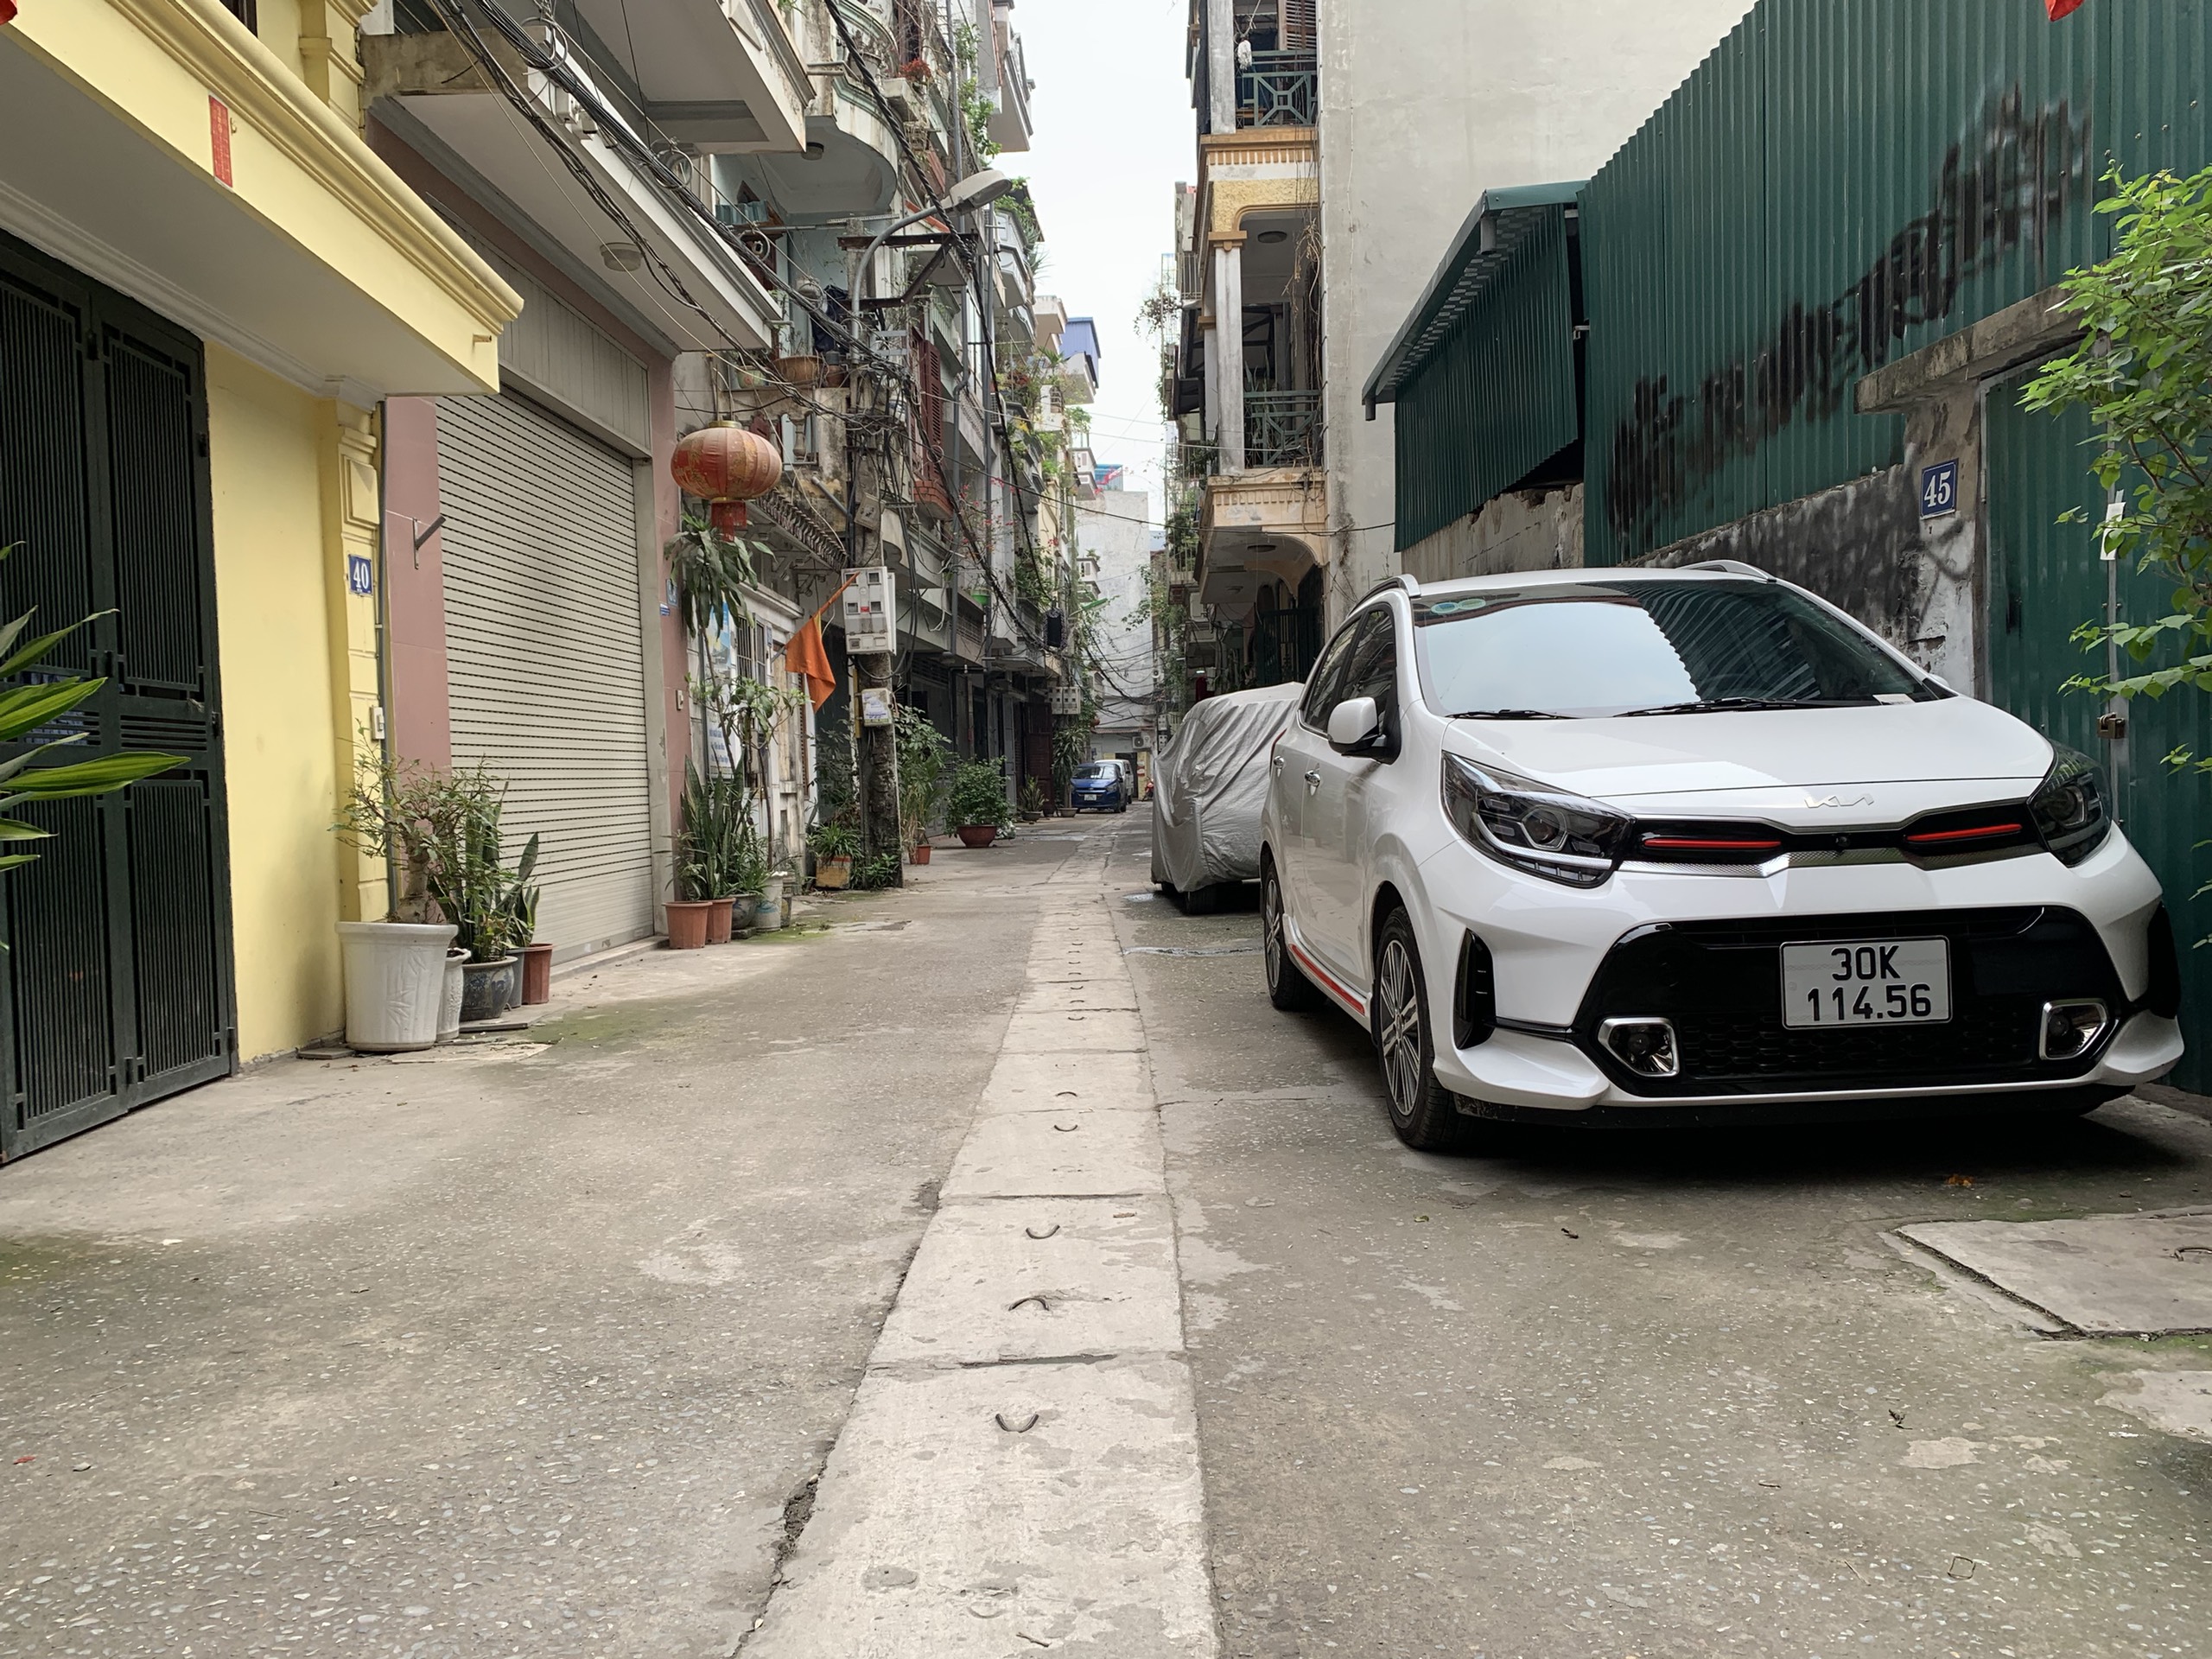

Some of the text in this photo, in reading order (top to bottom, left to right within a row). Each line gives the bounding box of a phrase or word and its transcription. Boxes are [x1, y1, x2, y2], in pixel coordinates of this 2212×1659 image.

[1924, 470, 1951, 507] 45
[353, 560, 369, 589] 40
[1831, 945, 1901, 981] 30K
[1808, 983, 1931, 1021] 114.56
